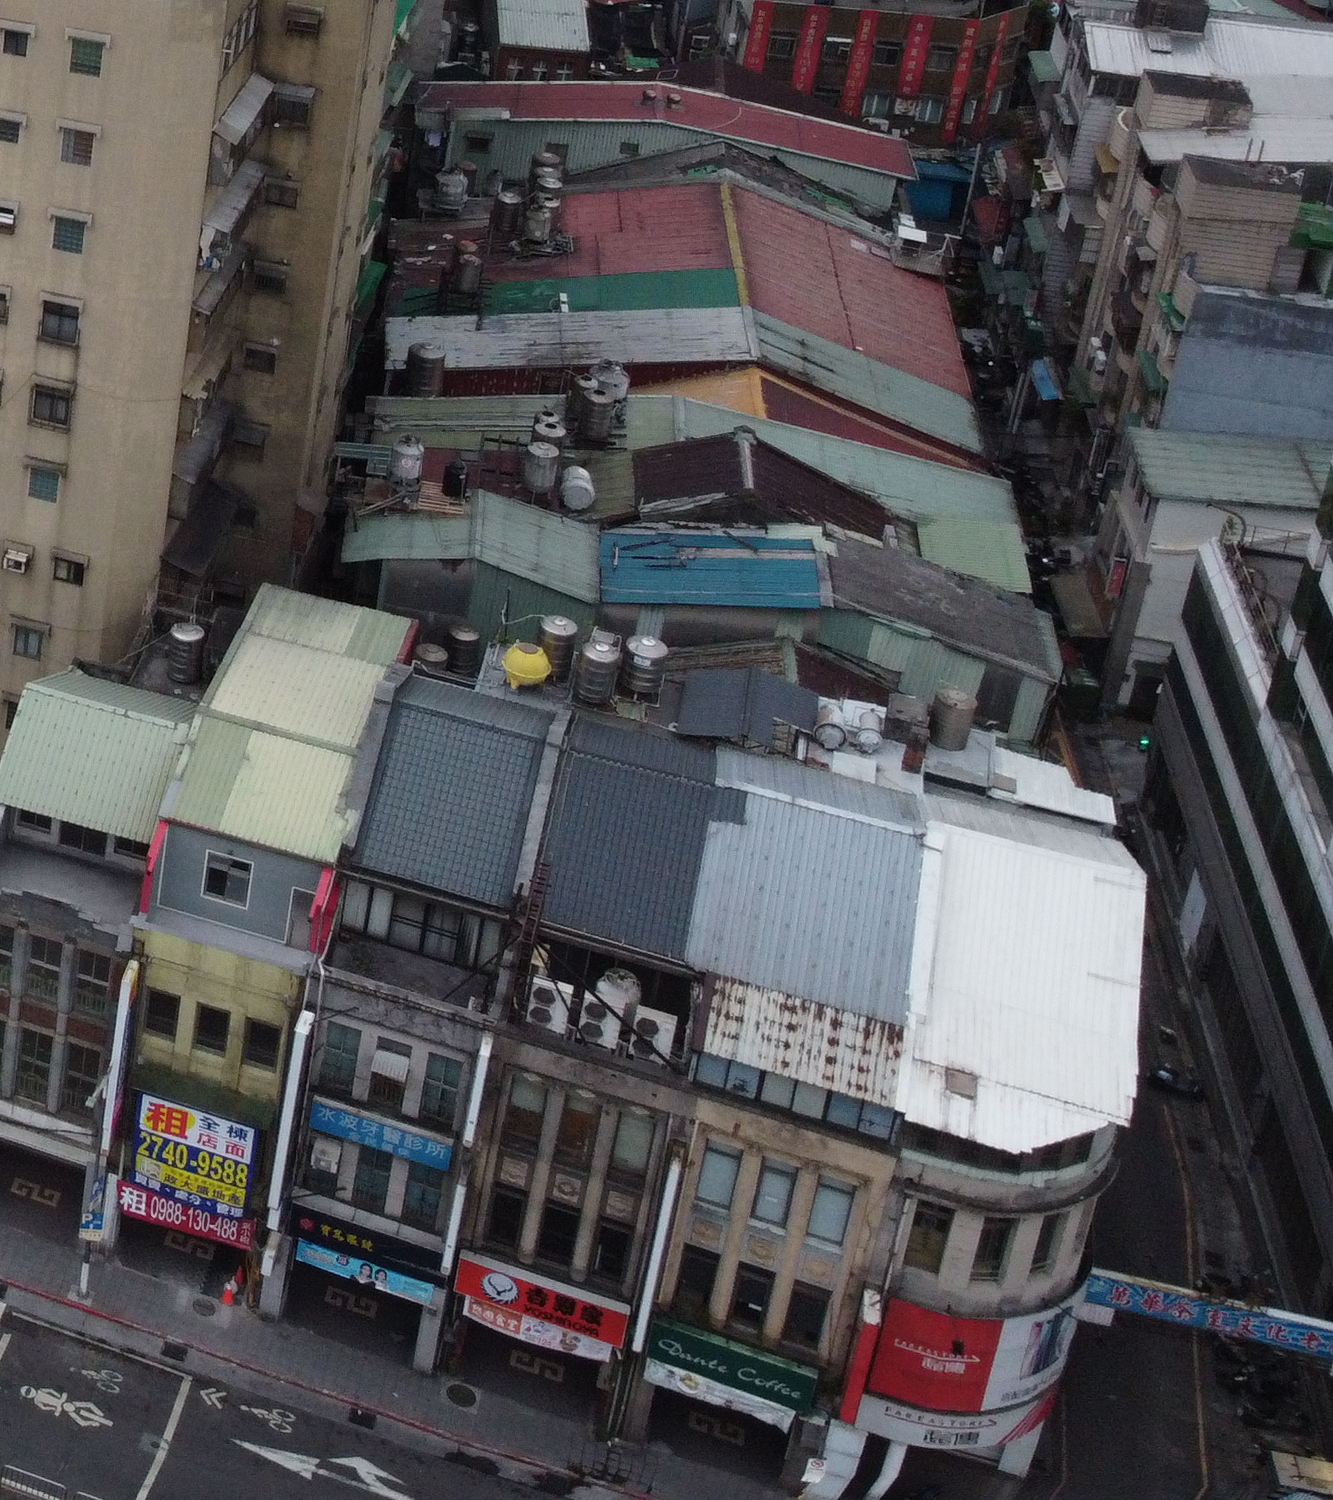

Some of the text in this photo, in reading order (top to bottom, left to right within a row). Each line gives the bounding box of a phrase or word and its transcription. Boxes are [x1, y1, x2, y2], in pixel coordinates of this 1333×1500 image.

[146, 1100, 190, 1140] 租
[197, 1132, 247, 1160] 店面
[137, 1131, 249, 1188] 2740-9588
[119, 1185, 147, 1217] 租
[150, 1195, 238, 1241] 0988-130-488
[658, 1338, 802, 1399] Dante Coffee
